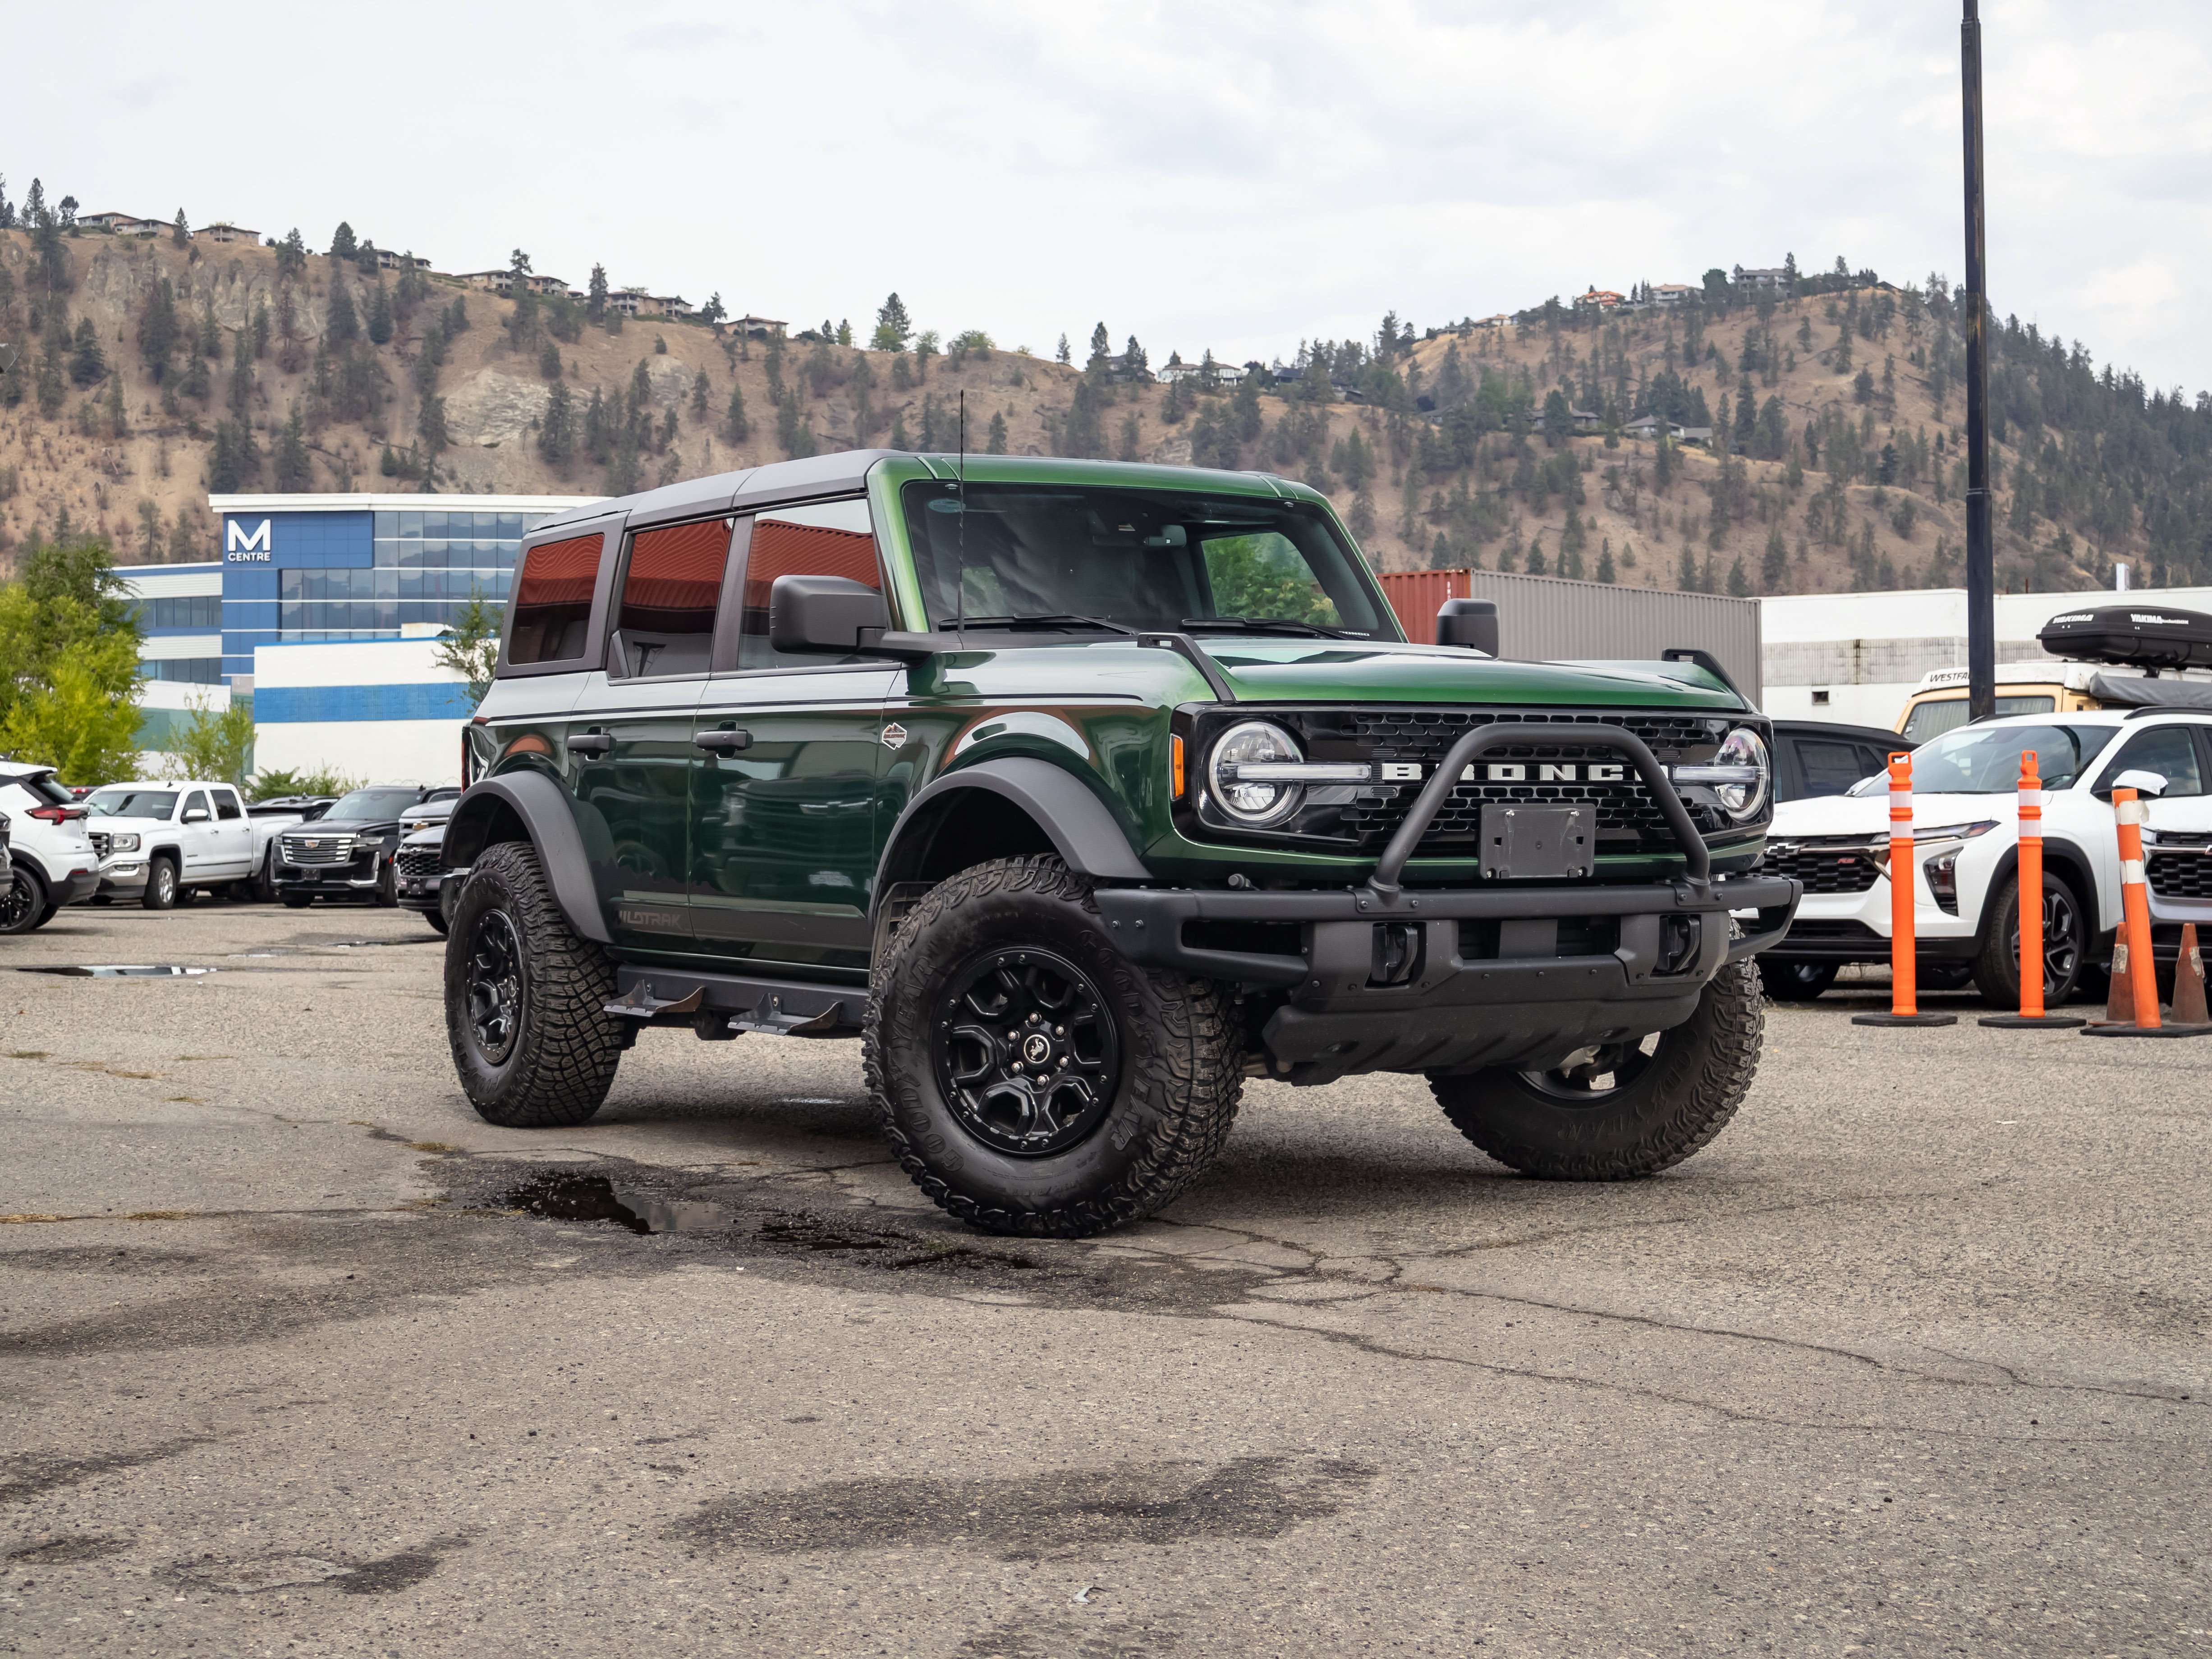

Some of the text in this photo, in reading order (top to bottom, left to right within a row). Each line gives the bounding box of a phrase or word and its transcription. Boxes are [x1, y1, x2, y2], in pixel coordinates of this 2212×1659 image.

[228, 519, 271, 551] M
[228, 552, 271, 561] CENTRE
[2052, 614, 2093, 624] YAKIMA
[2130, 614, 2162, 624] YAKIMA
[1930, 672, 1969, 682] WESTFA
